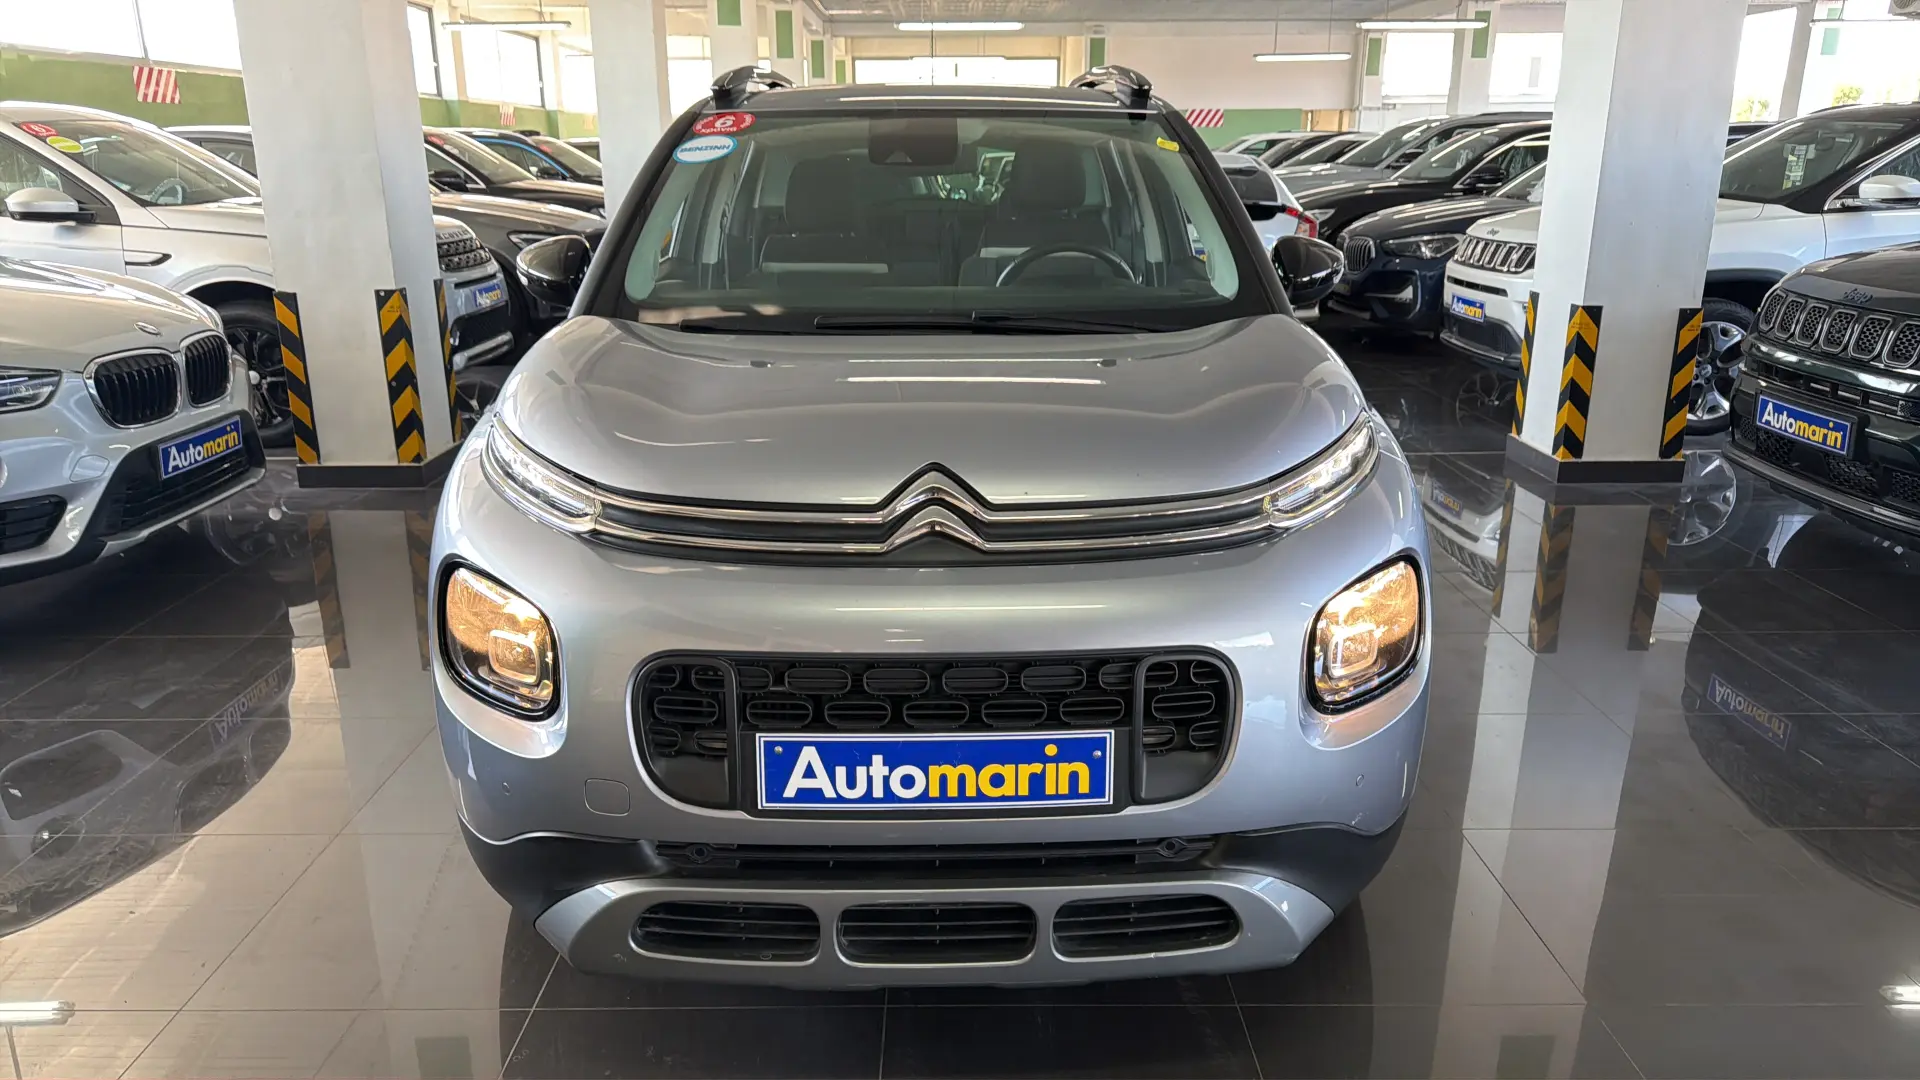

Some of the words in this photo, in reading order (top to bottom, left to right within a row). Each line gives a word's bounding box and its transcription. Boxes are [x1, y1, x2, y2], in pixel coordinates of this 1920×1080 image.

[715, 115, 735, 128] 6
[1762, 402, 1842, 448] Automarin
[168, 426, 239, 473] Automarin
[782, 744, 1090, 799] Automarin
